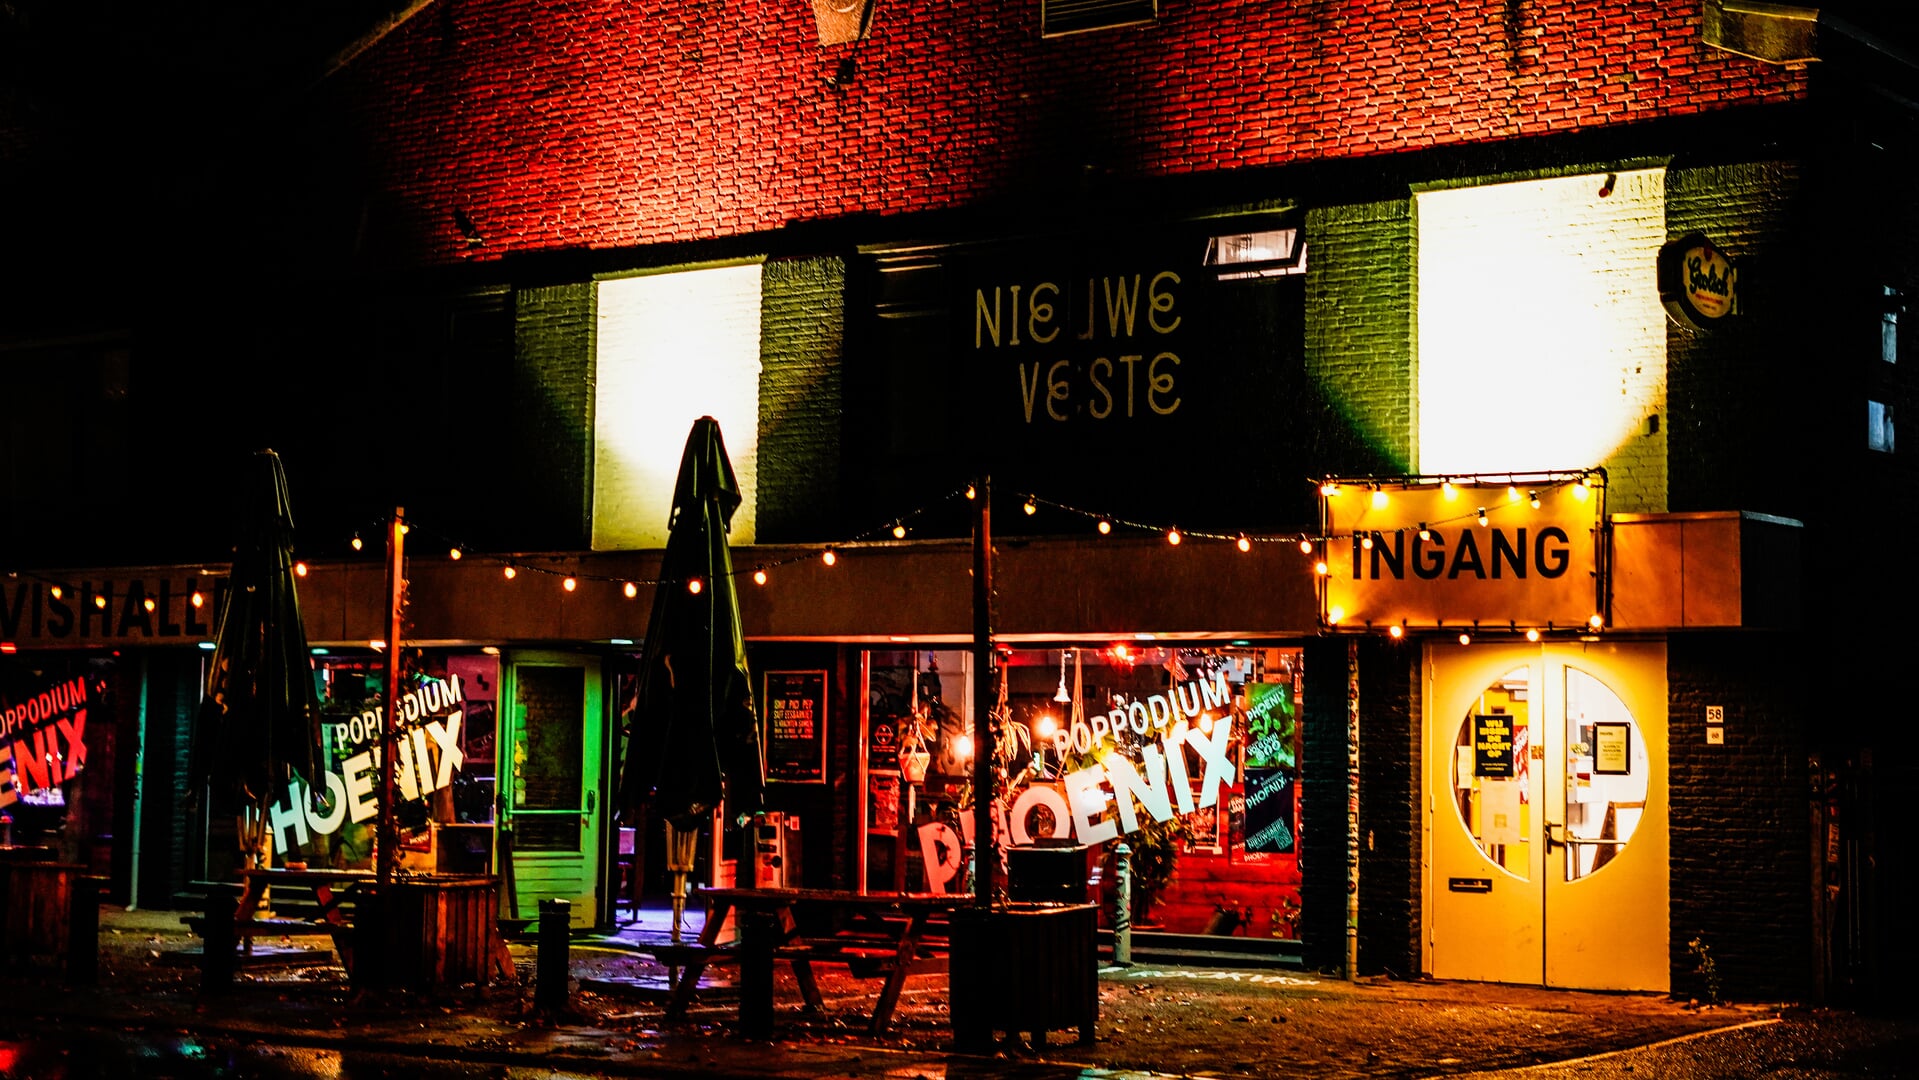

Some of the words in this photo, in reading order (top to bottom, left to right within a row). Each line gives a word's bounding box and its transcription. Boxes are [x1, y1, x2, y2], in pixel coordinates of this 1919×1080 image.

[1019, 351, 1181, 423] VESTE
[1352, 526, 1570, 580] INGANG
[1053, 671, 1230, 757] POPPODIUM
[1245, 689, 1285, 721] PHOENIX
[1709, 709, 1722, 720] 58
[917, 716, 1236, 895] PHOENIX
